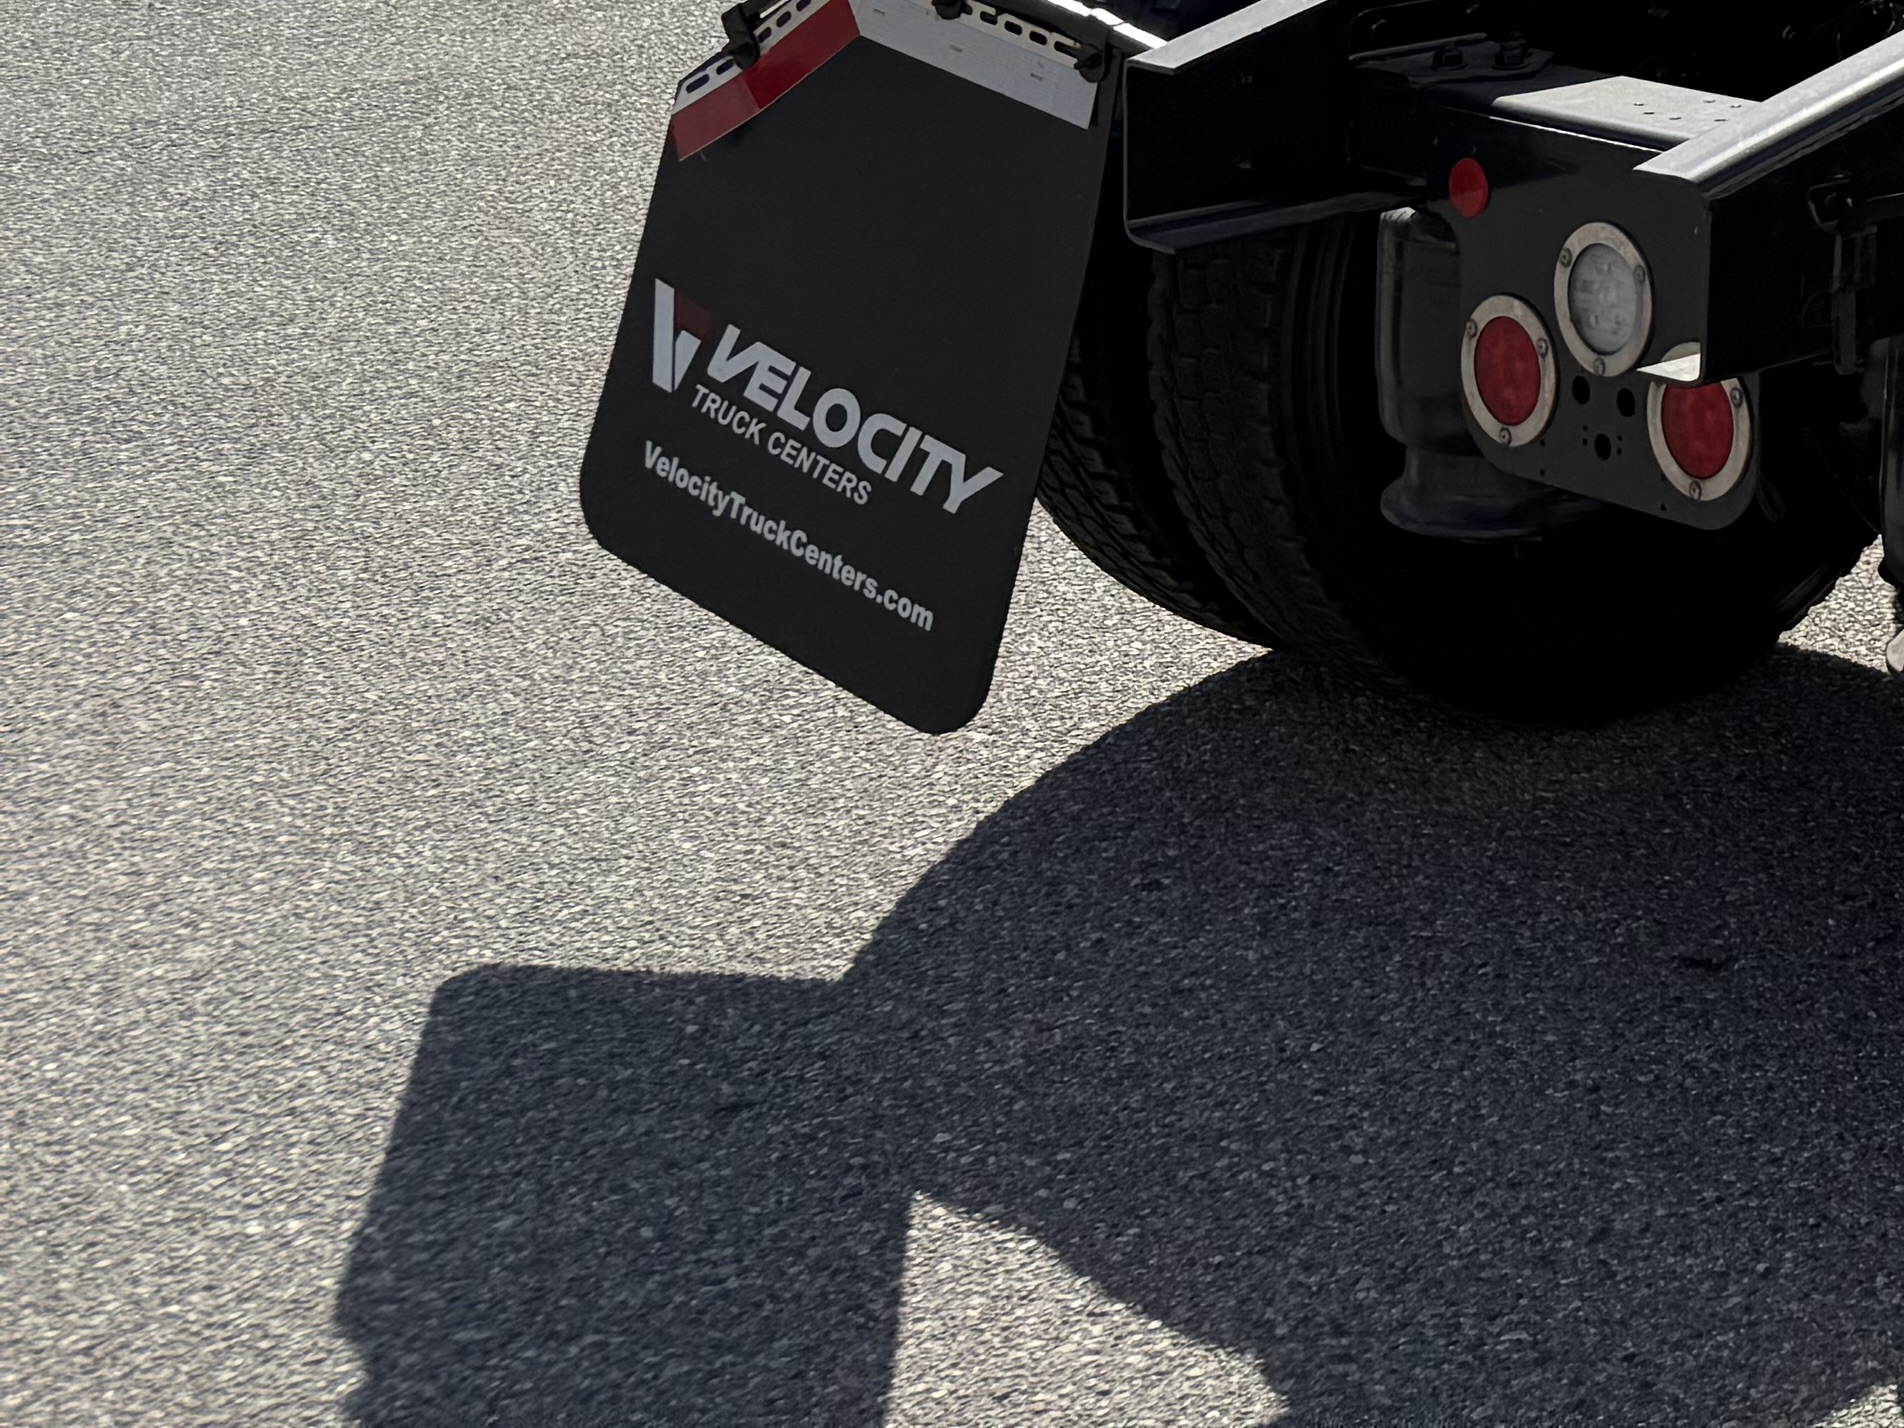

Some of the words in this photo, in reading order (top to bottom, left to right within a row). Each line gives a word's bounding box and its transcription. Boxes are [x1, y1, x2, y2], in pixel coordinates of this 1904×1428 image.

[690, 383, 768, 446] TRUCK
[767, 430, 874, 506] CENTERS
[706, 323, 1004, 515] VELOCITY
[644, 440, 934, 632] VelocityTruckCenters.com
